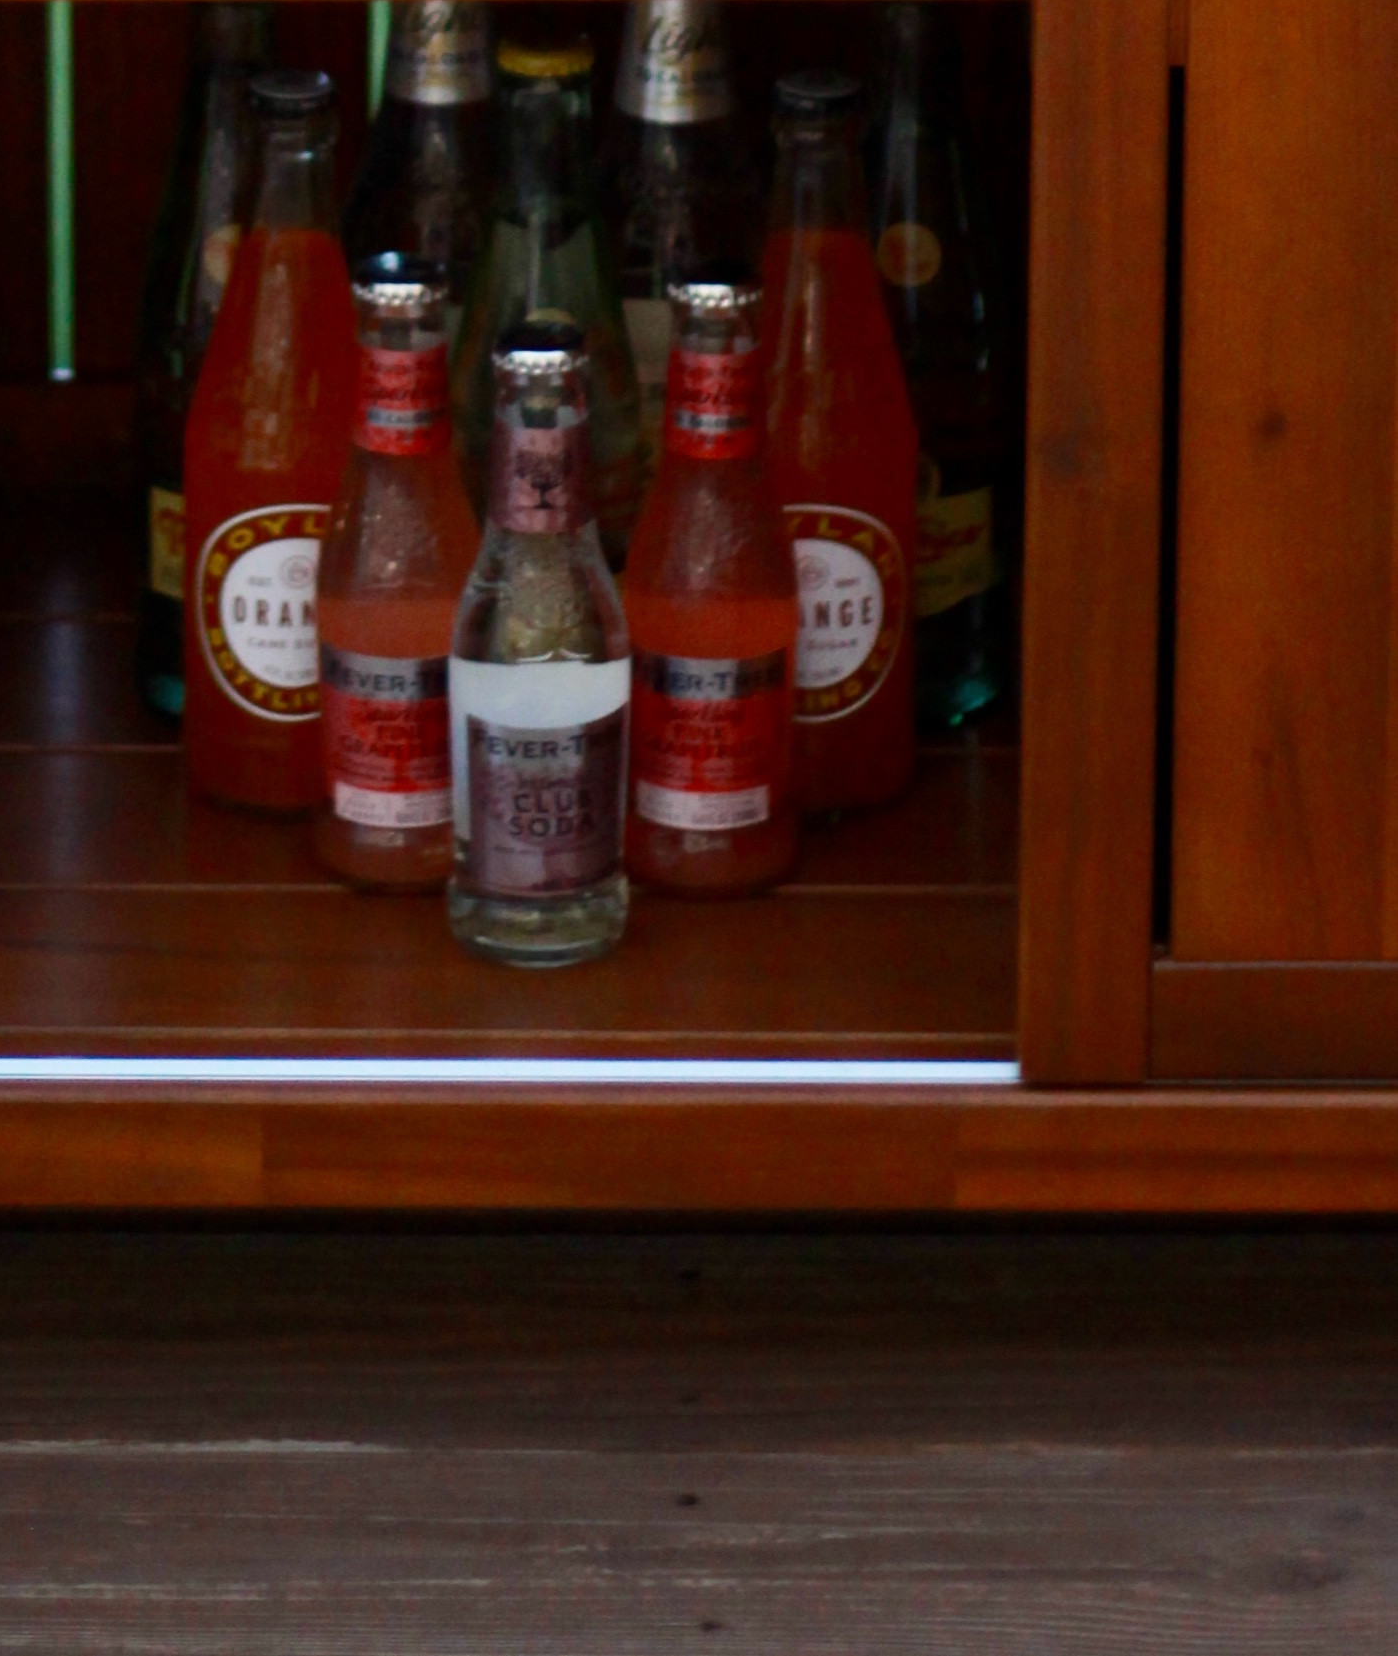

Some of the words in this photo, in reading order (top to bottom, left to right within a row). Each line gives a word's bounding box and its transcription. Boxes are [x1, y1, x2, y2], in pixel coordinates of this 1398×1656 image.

[208, 515, 325, 576] BOYL
[233, 596, 317, 627] ORAN
[514, 790, 590, 813] CLUB
[509, 815, 593, 837] SODA
